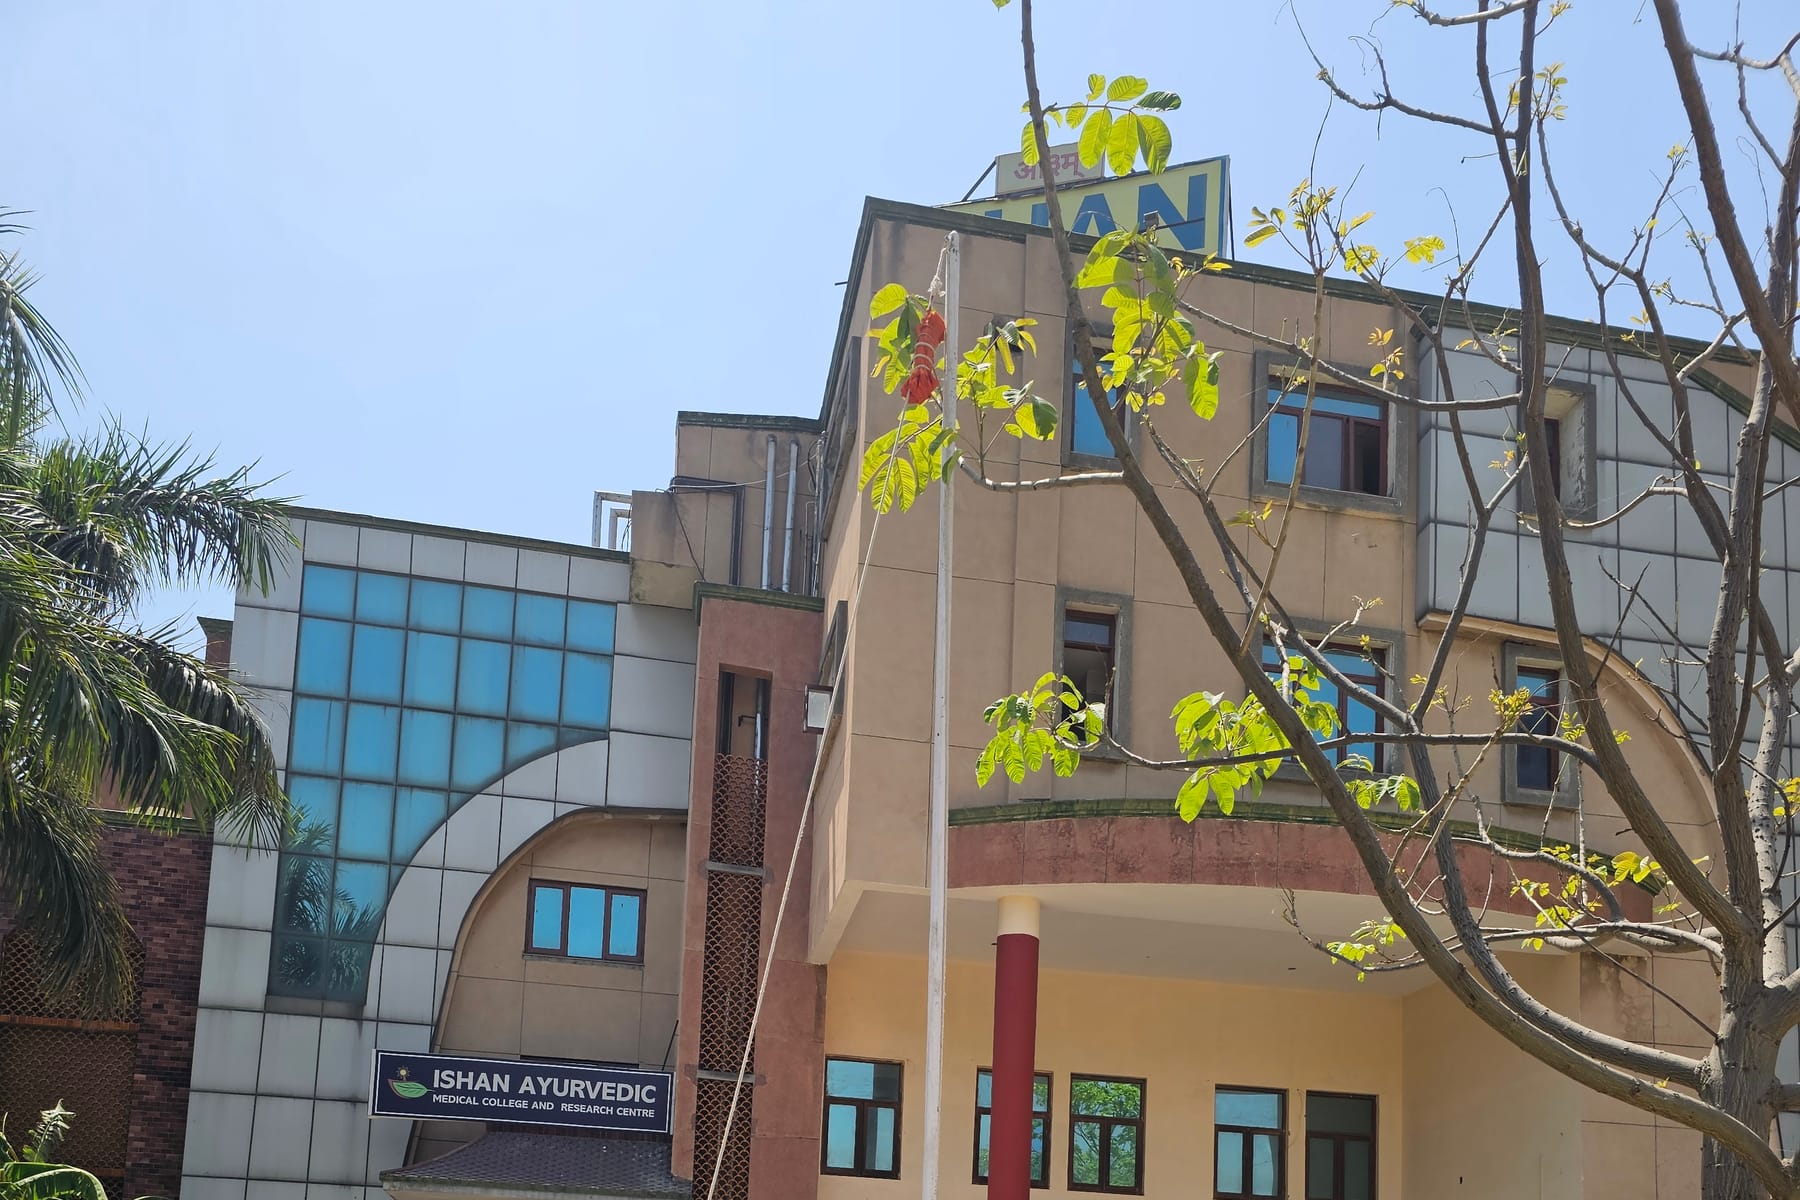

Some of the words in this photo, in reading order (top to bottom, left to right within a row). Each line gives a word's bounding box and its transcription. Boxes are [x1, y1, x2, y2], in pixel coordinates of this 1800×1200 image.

[432, 1069, 510, 1093] ISHAN
[518, 1076, 656, 1104] AYURVEDIC
[432, 1093, 479, 1106] MEDICAL
[481, 1097, 529, 1110] COLLEGE
[531, 1101, 555, 1111] AND
[560, 1103, 614, 1116] RESEARCH
[616, 1107, 655, 1118] CENTRE
